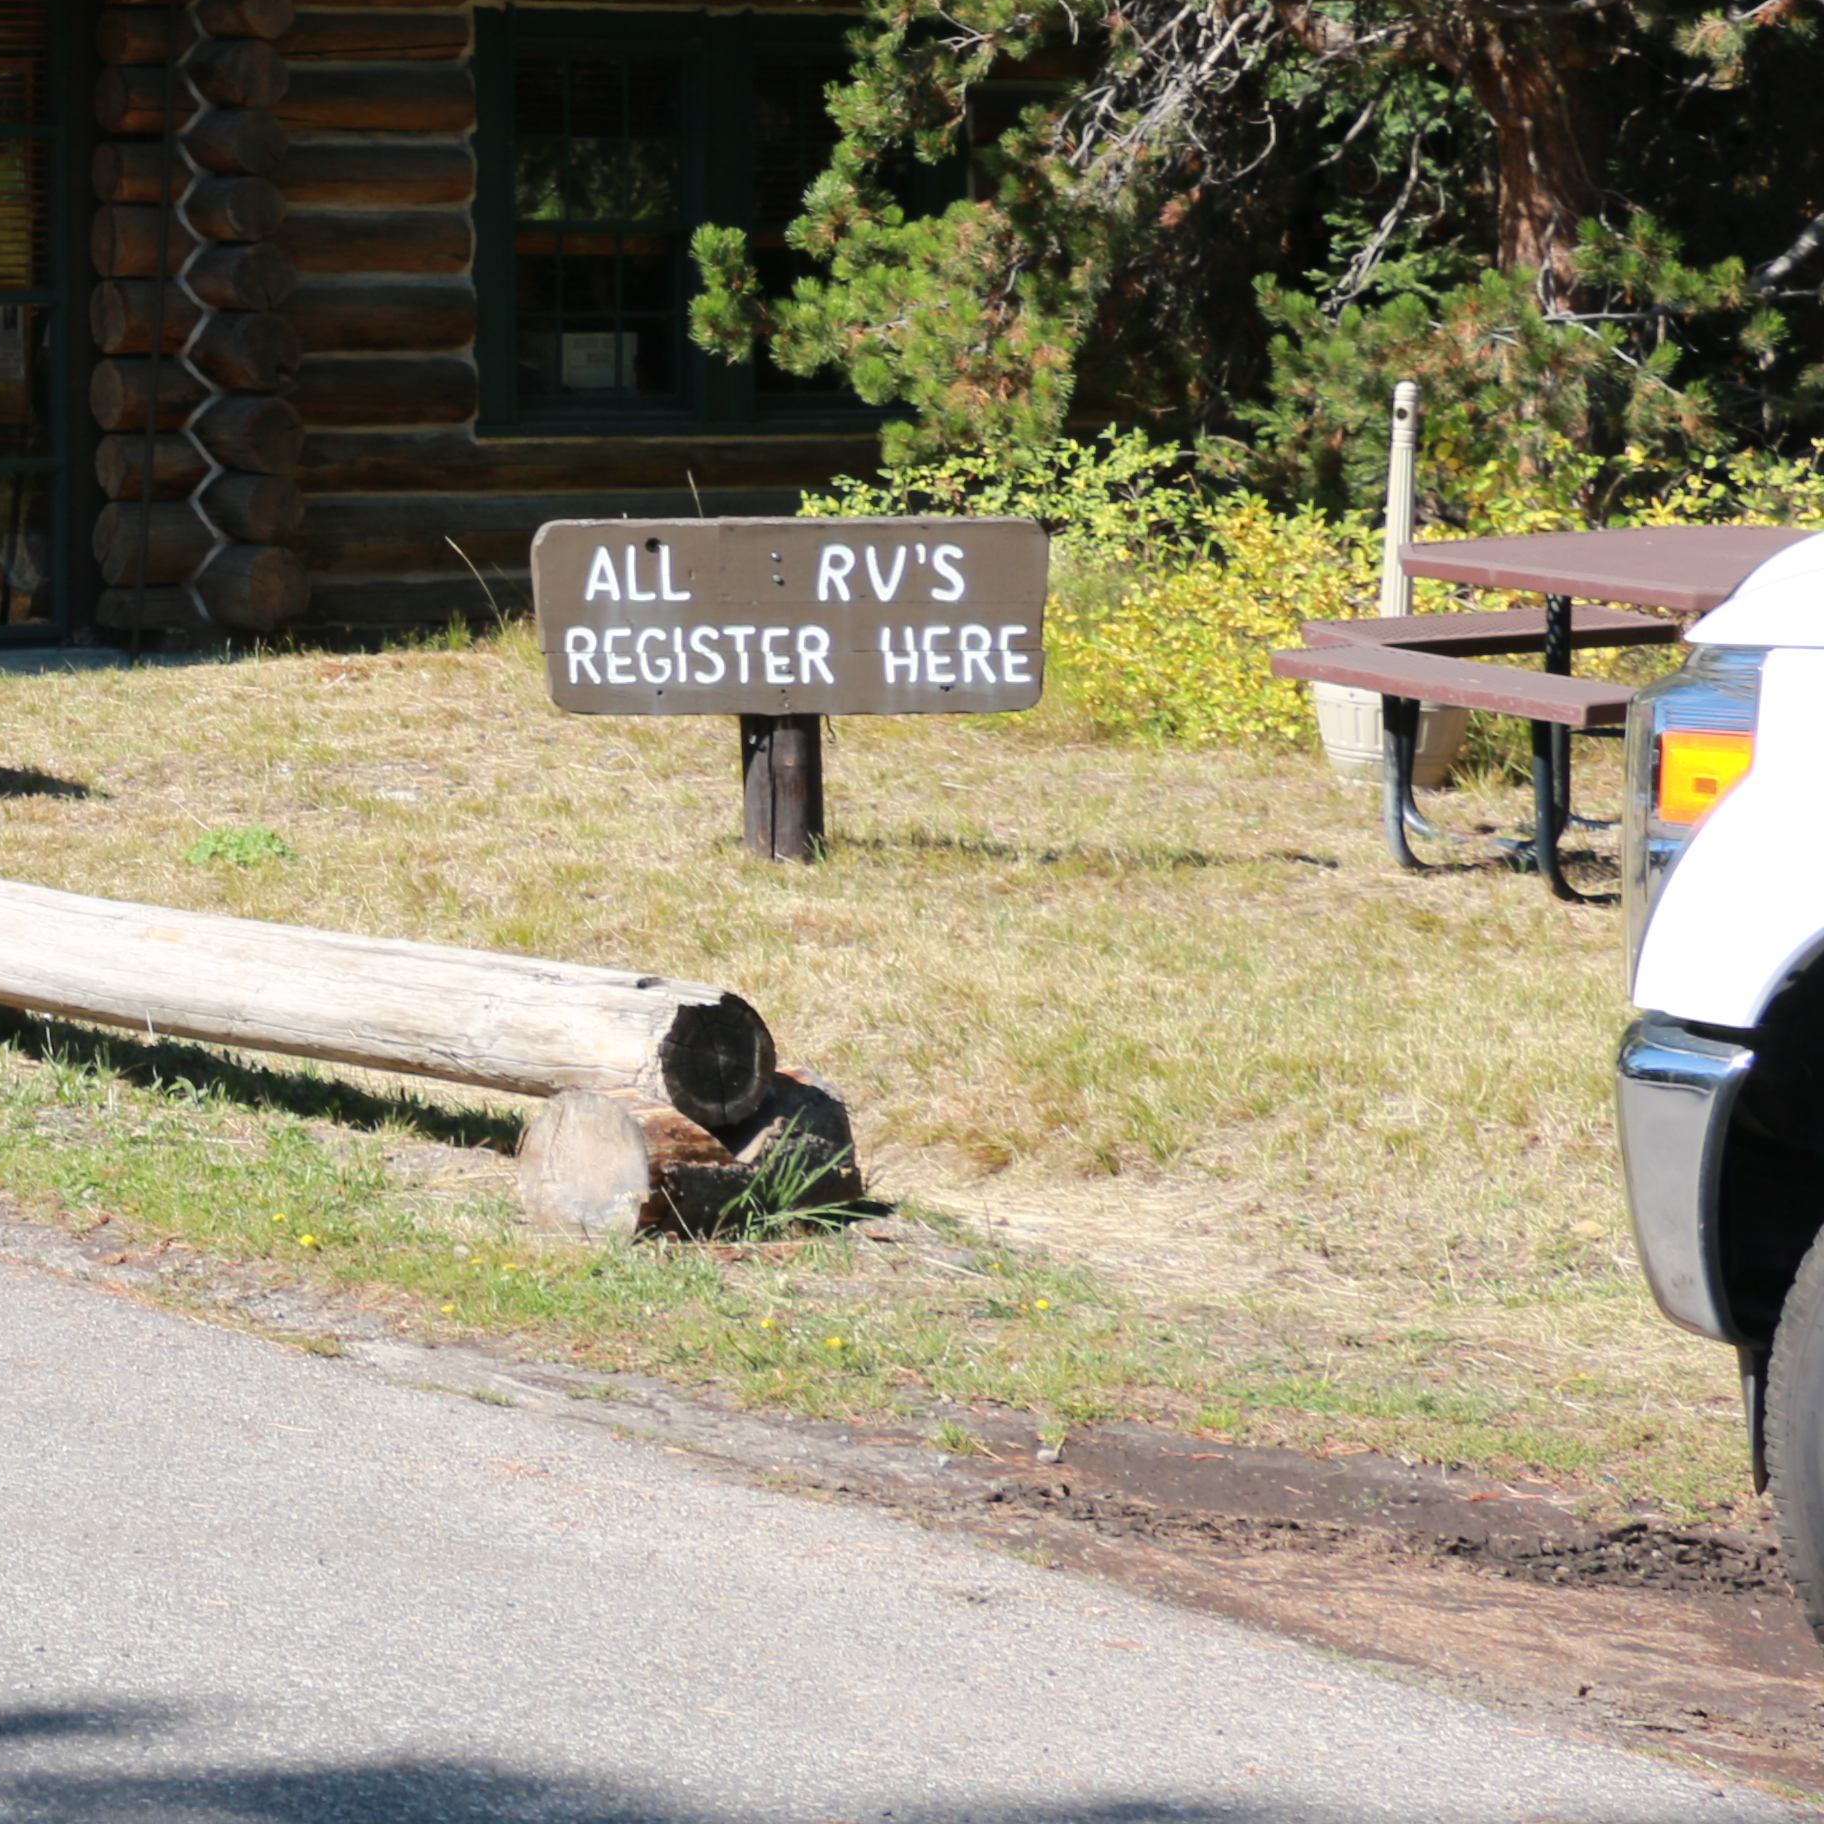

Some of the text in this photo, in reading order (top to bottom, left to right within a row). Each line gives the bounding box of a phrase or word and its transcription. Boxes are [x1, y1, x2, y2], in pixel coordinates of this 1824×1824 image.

[584, 543, 966, 603] ALL RV'S
[564, 625, 1034, 685] REGISTER HERE
